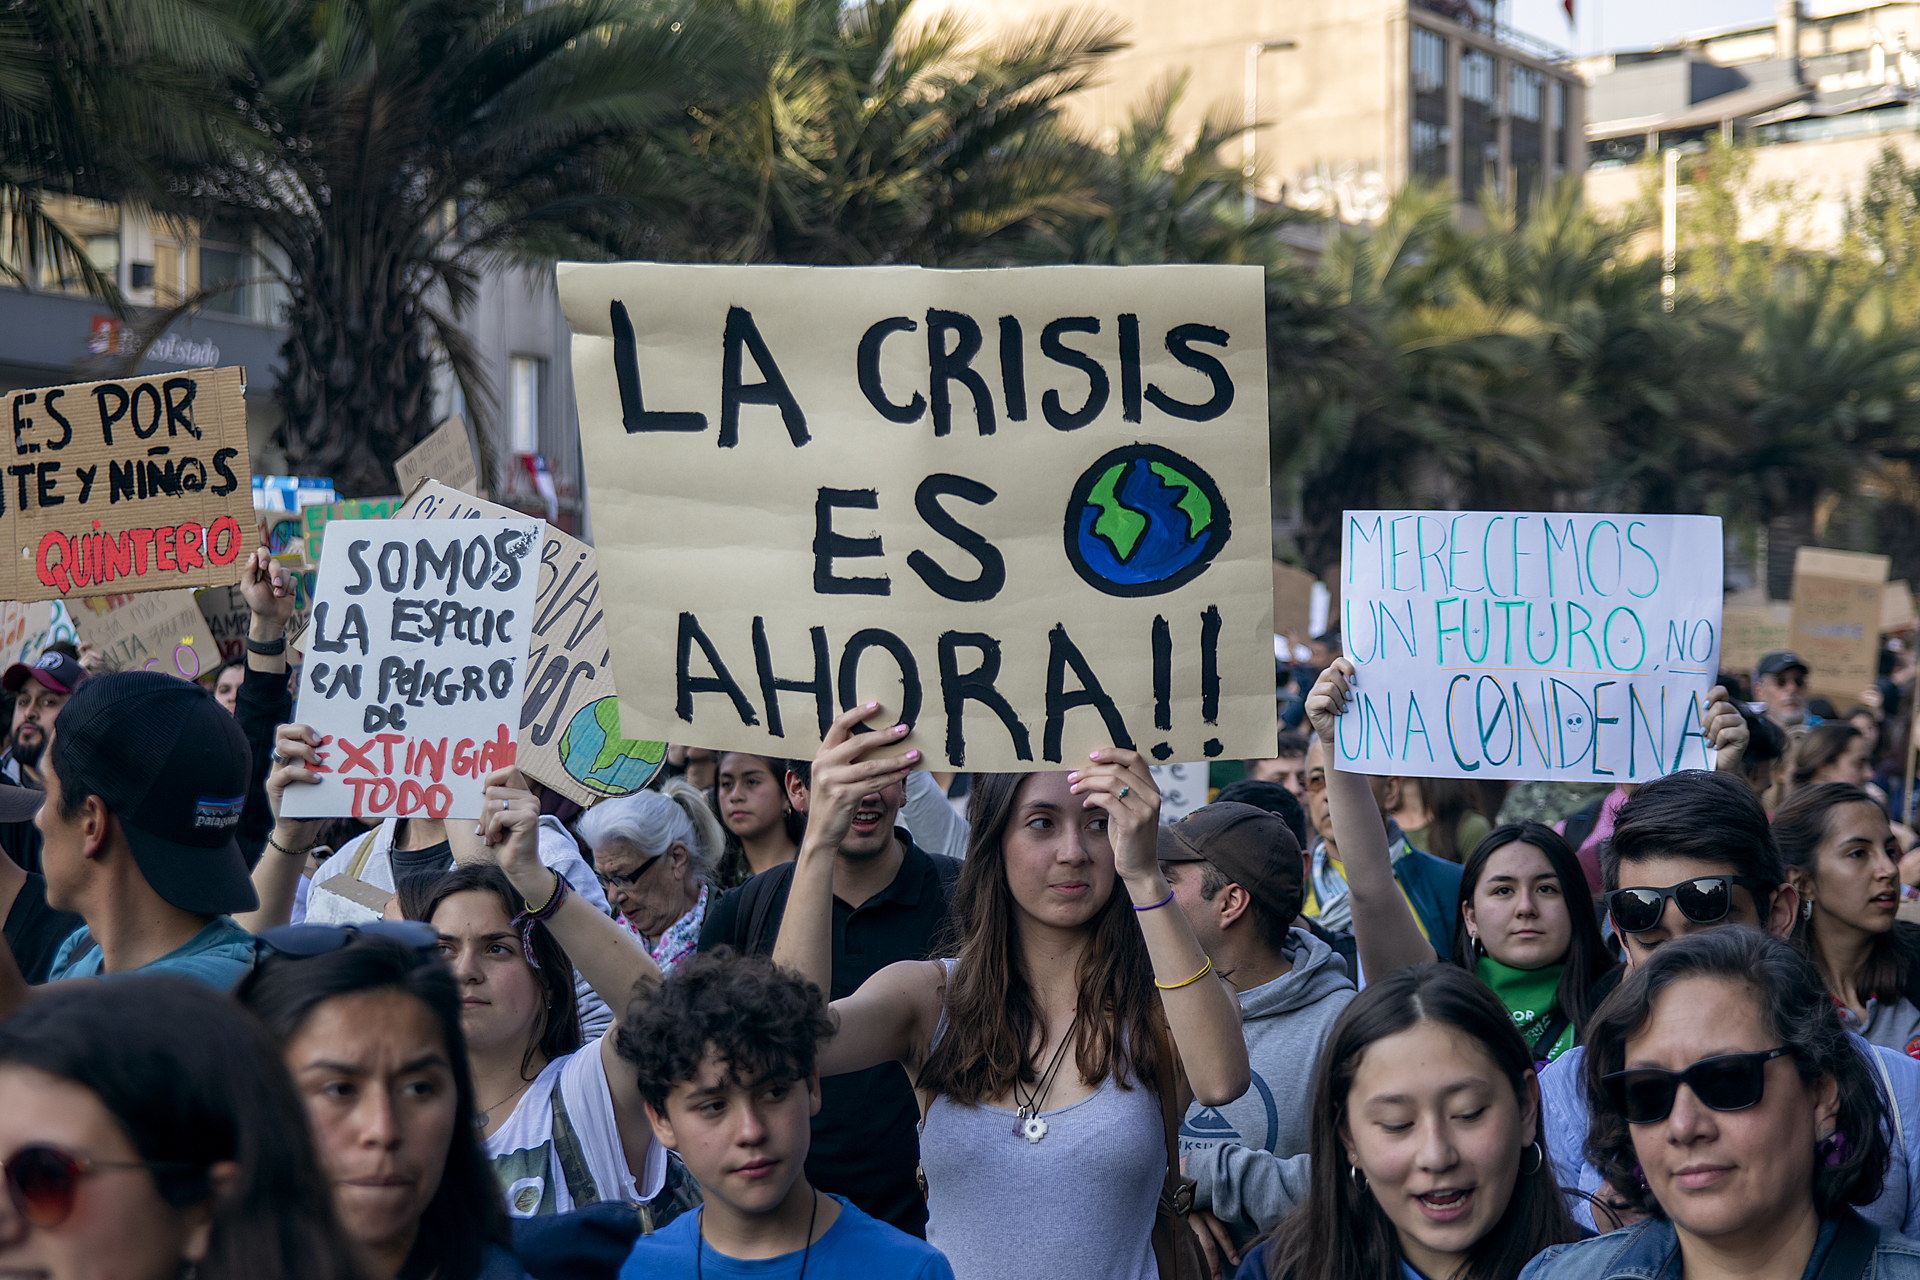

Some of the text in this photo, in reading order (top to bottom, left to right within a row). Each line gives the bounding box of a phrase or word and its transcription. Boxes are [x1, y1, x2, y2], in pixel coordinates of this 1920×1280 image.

[610, 298, 1236, 449] LA CRISIS
[13, 377, 202, 455] ES POR
[344, 528, 524, 596] SOMOS
[813, 472, 1007, 603] ES
[1348, 513, 1660, 599] MERECEMOS
[312, 601, 370, 656] LA
[1346, 598, 1418, 666] UN
[1666, 618, 1714, 664] NO
[675, 603, 1224, 768] AHORA!!
[1338, 689, 1435, 763] UNA
[342, 776, 454, 819] TODO
